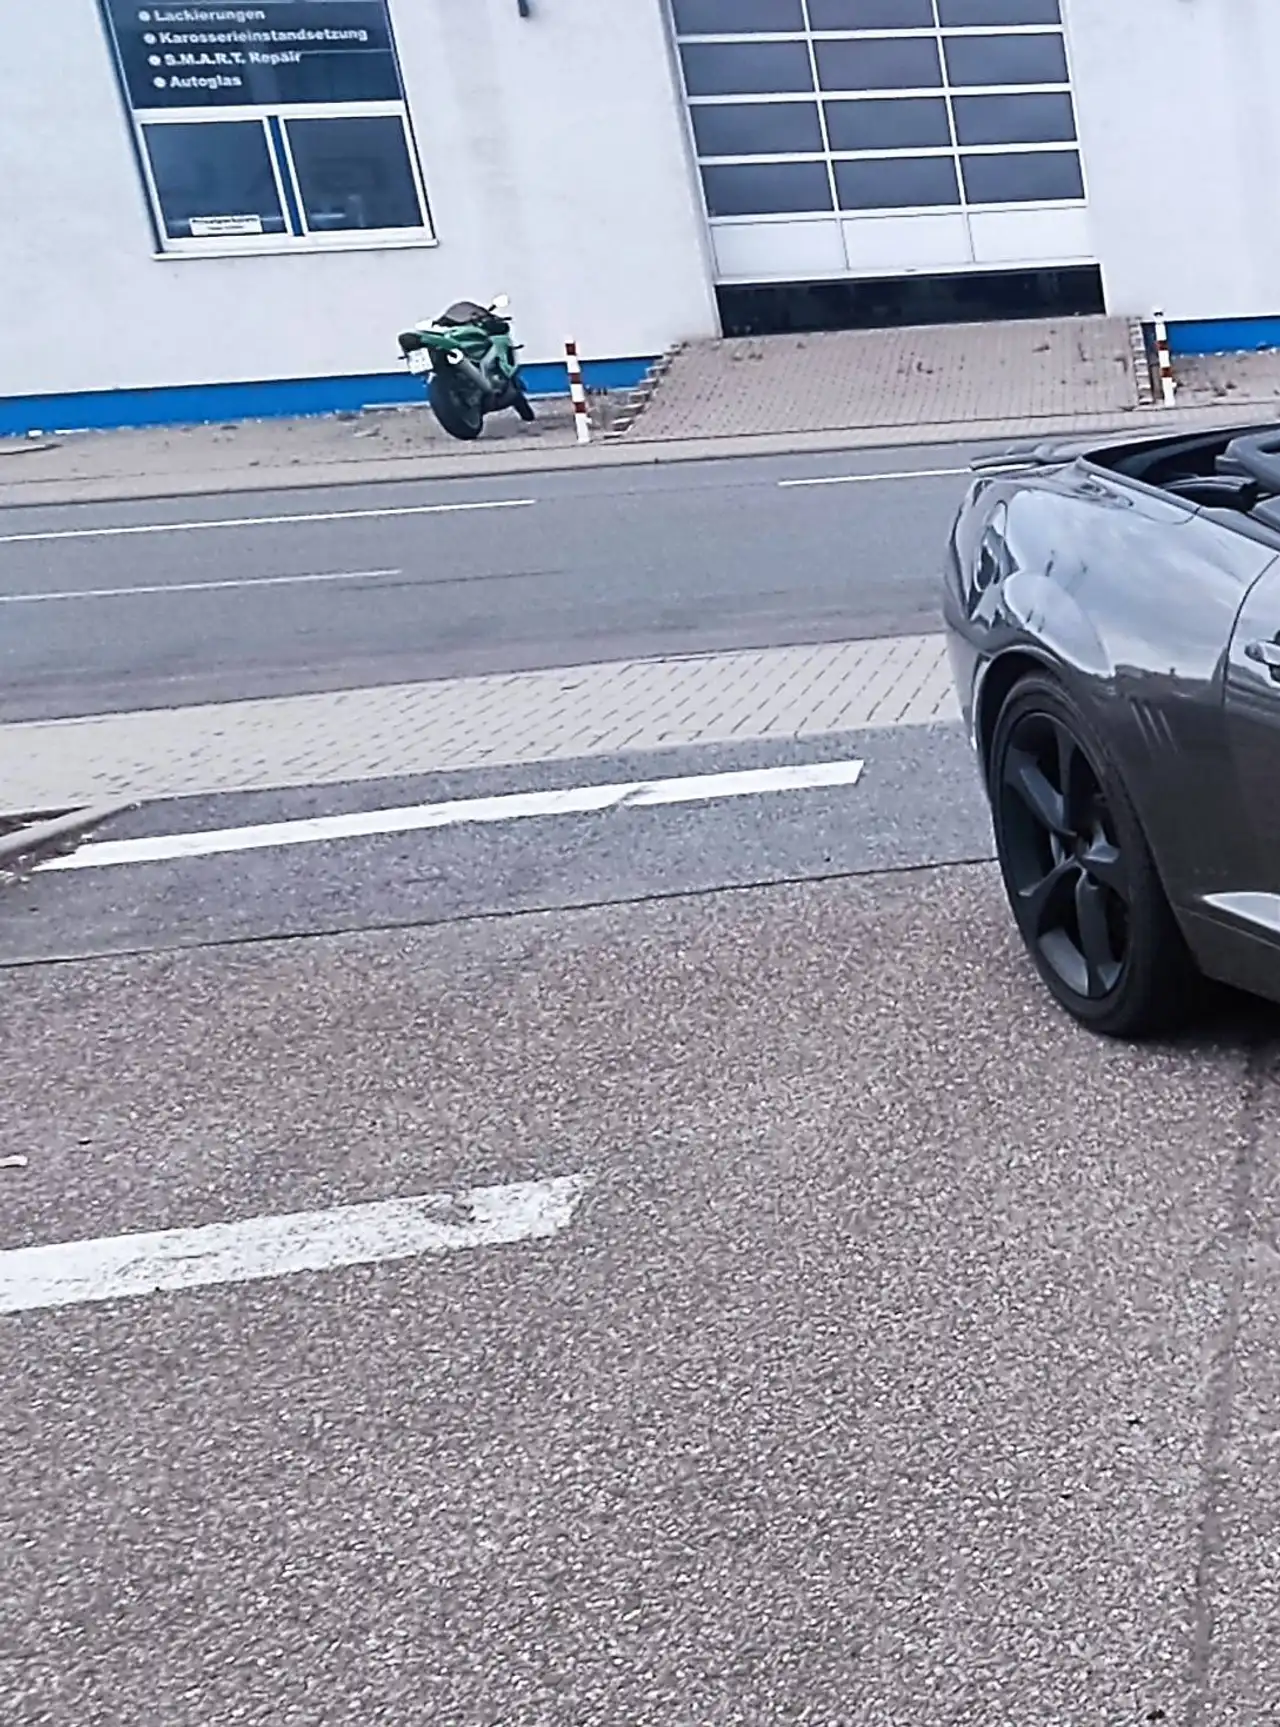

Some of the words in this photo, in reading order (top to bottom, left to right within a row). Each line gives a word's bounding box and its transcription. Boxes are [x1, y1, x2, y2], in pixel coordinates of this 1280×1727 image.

[154, 9, 265, 23] Lackierungen
[160, 28, 368, 43] Karosserieinstandsetzung
[164, 52, 246, 66] S.M.A.R.T.
[250, 50, 301, 64] Repair
[169, 75, 242, 89] Autoglas
